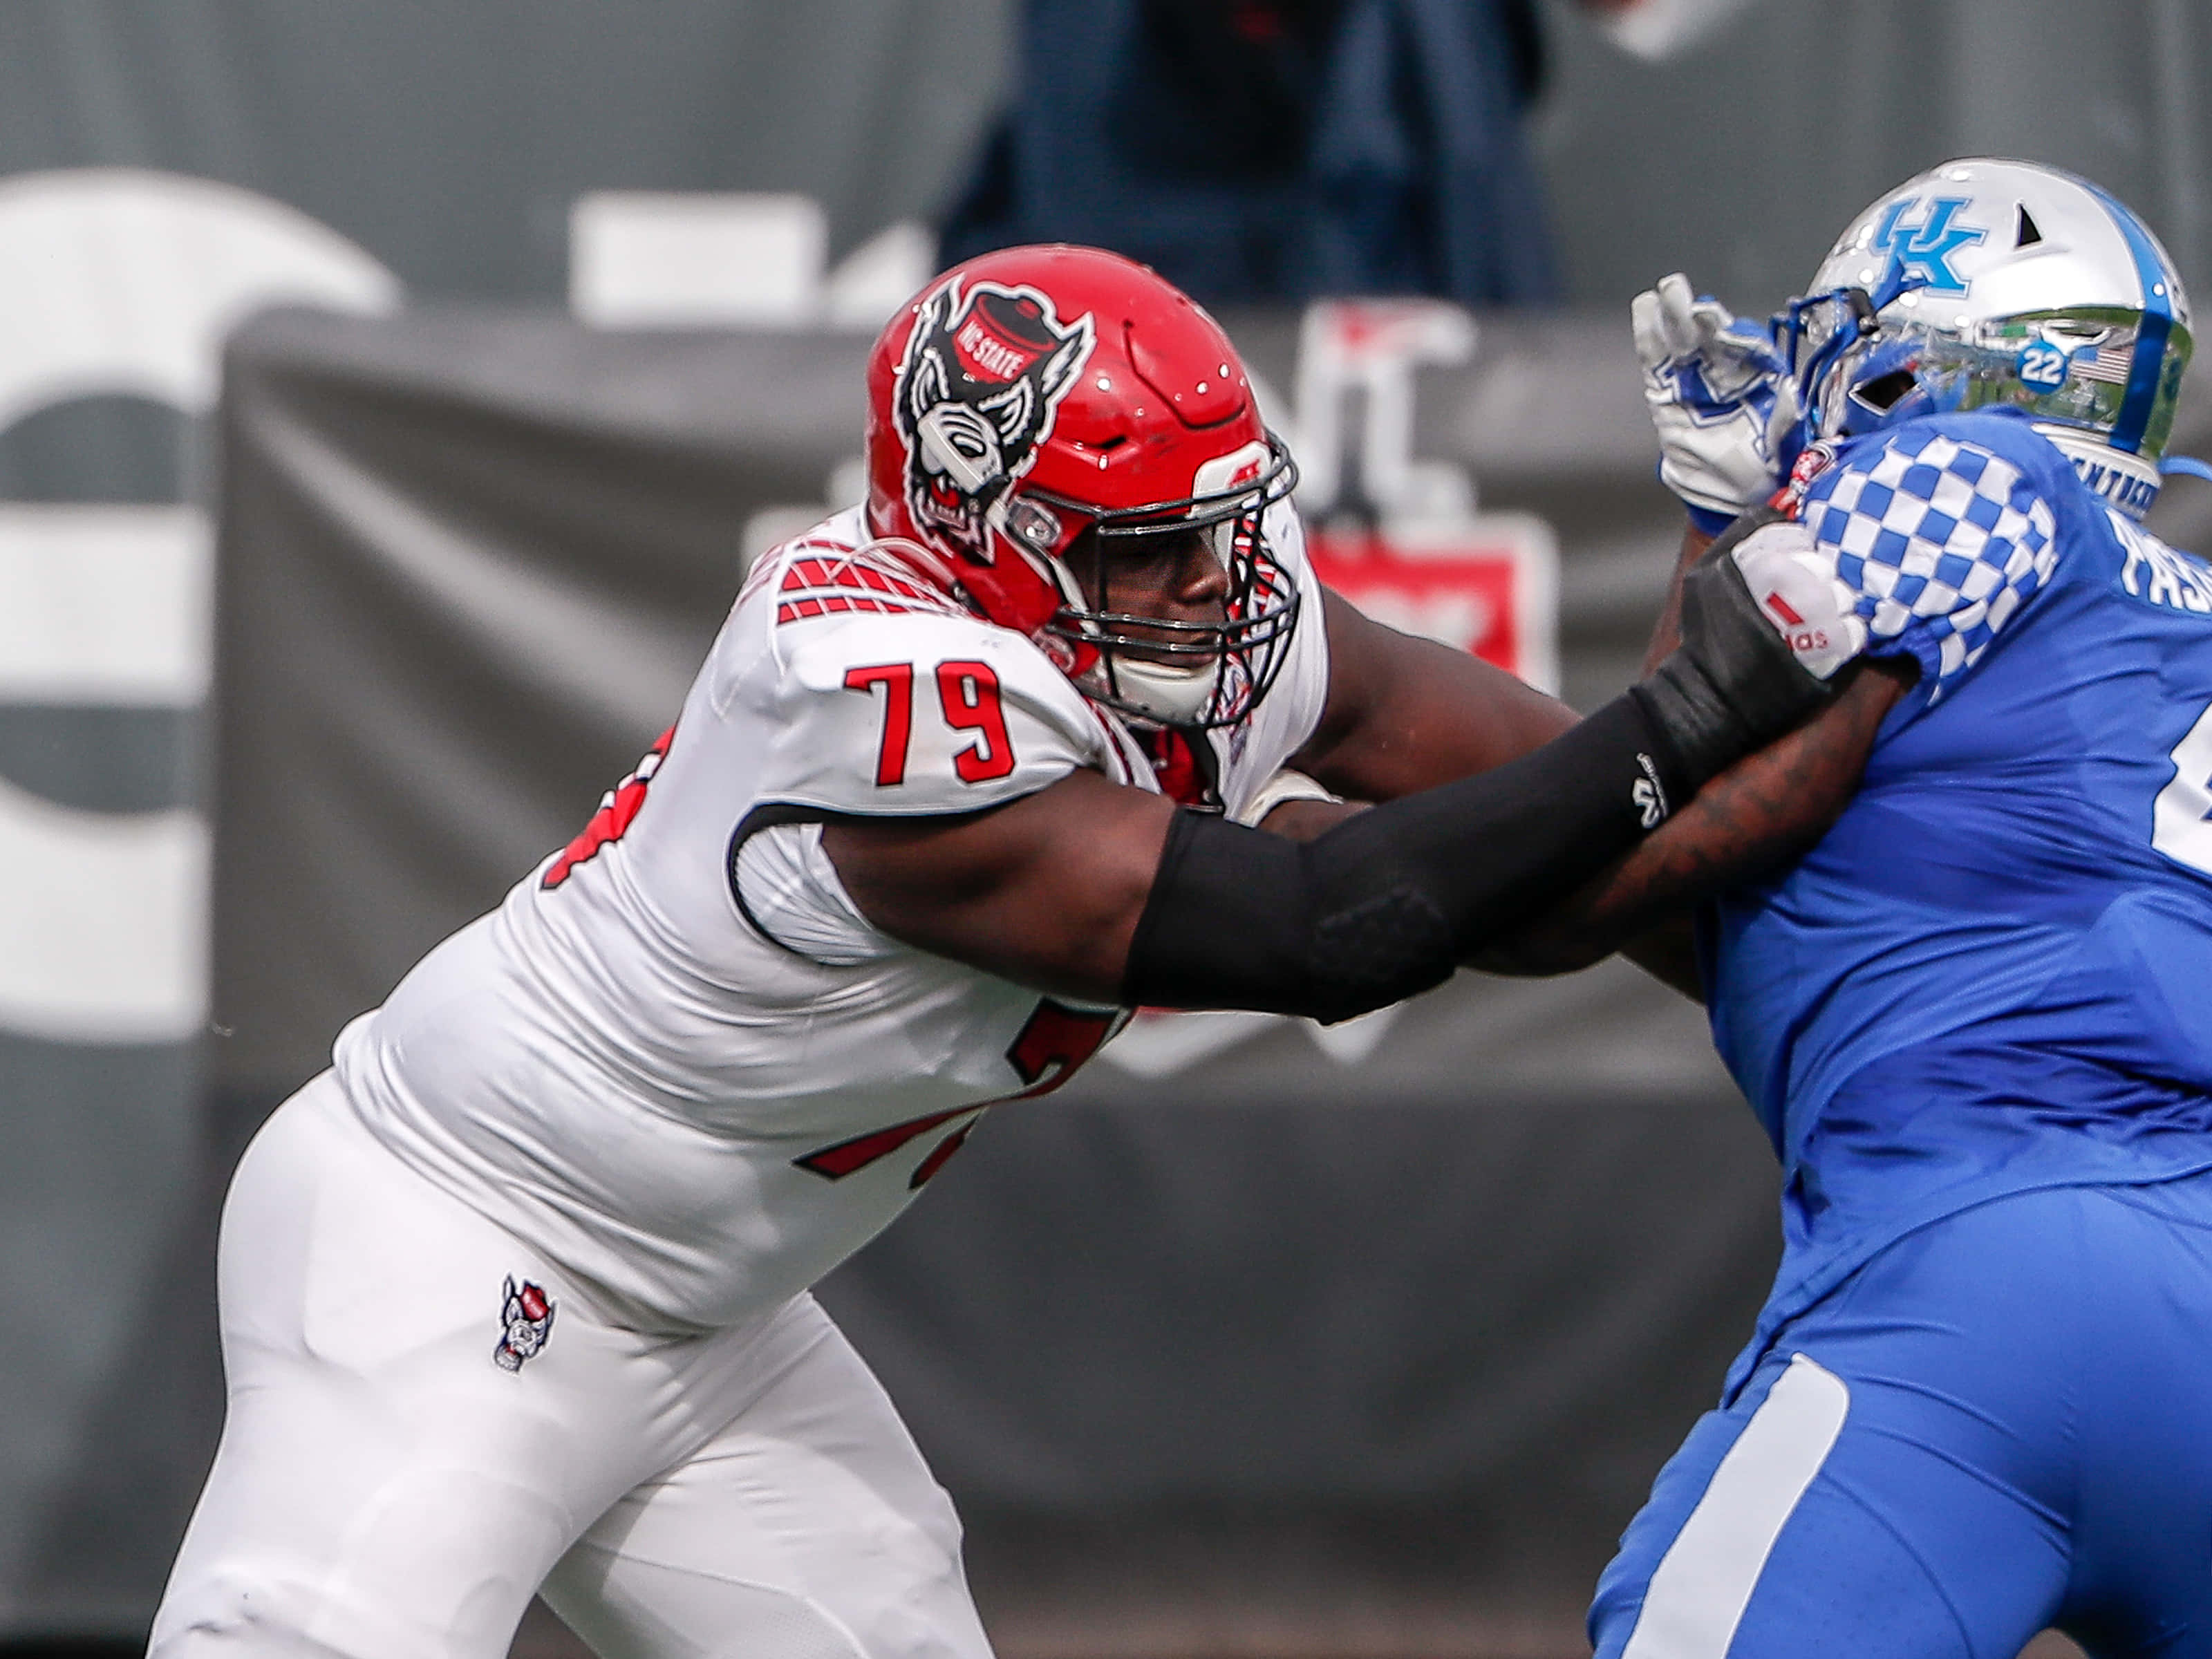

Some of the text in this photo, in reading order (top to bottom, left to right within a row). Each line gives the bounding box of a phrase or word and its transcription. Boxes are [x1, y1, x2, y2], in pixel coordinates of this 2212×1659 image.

[957, 320, 1025, 379] NC STATE
[2021, 347, 2064, 385] 22
[843, 659, 1016, 787] 79
